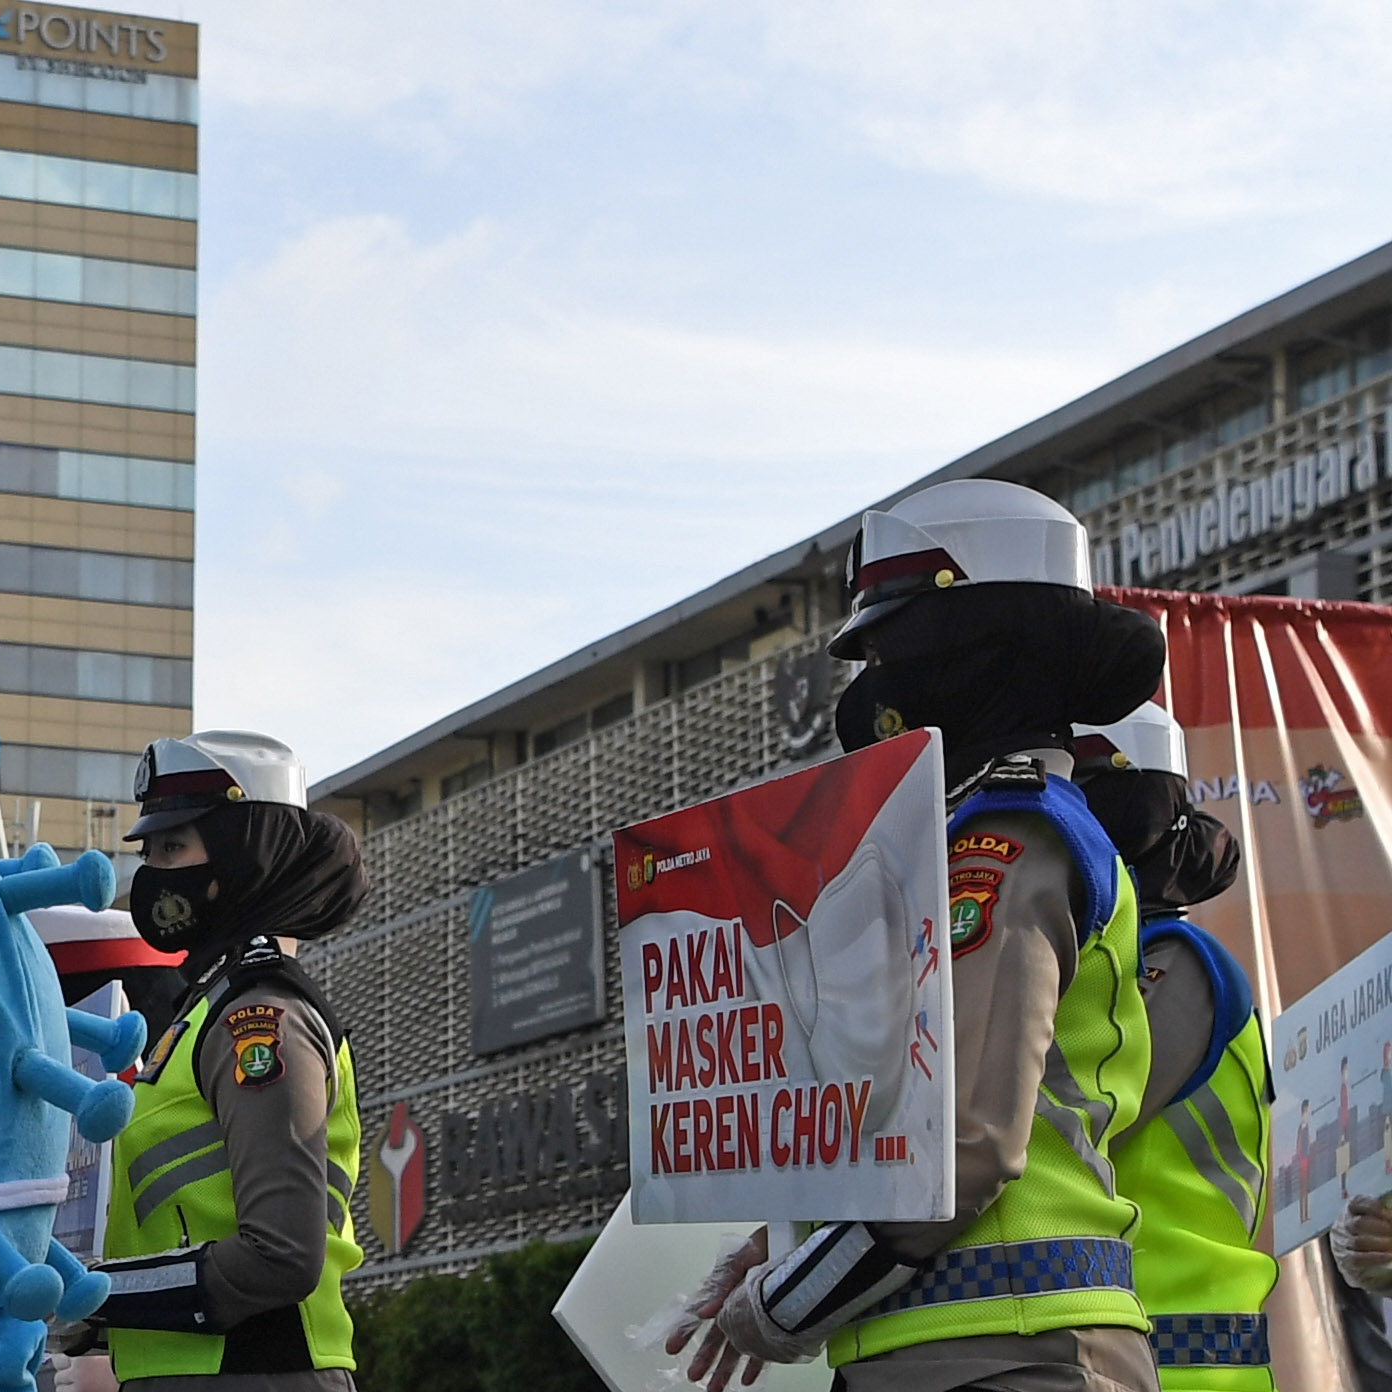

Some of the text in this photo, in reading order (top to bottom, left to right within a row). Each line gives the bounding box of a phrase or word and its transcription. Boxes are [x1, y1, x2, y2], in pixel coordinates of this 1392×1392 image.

[17, 9, 168, 63] POINTS
[1119, 431, 1378, 587] Penyelenggara
[949, 836, 1010, 856] OLDA
[642, 920, 744, 1013] PAKAI
[1316, 964, 1392, 1054] JAGA JARAK
[228, 1006, 275, 1025] POLDA
[646, 1003, 788, 1095] MASKER
[649, 1092, 760, 1175] KEREN
